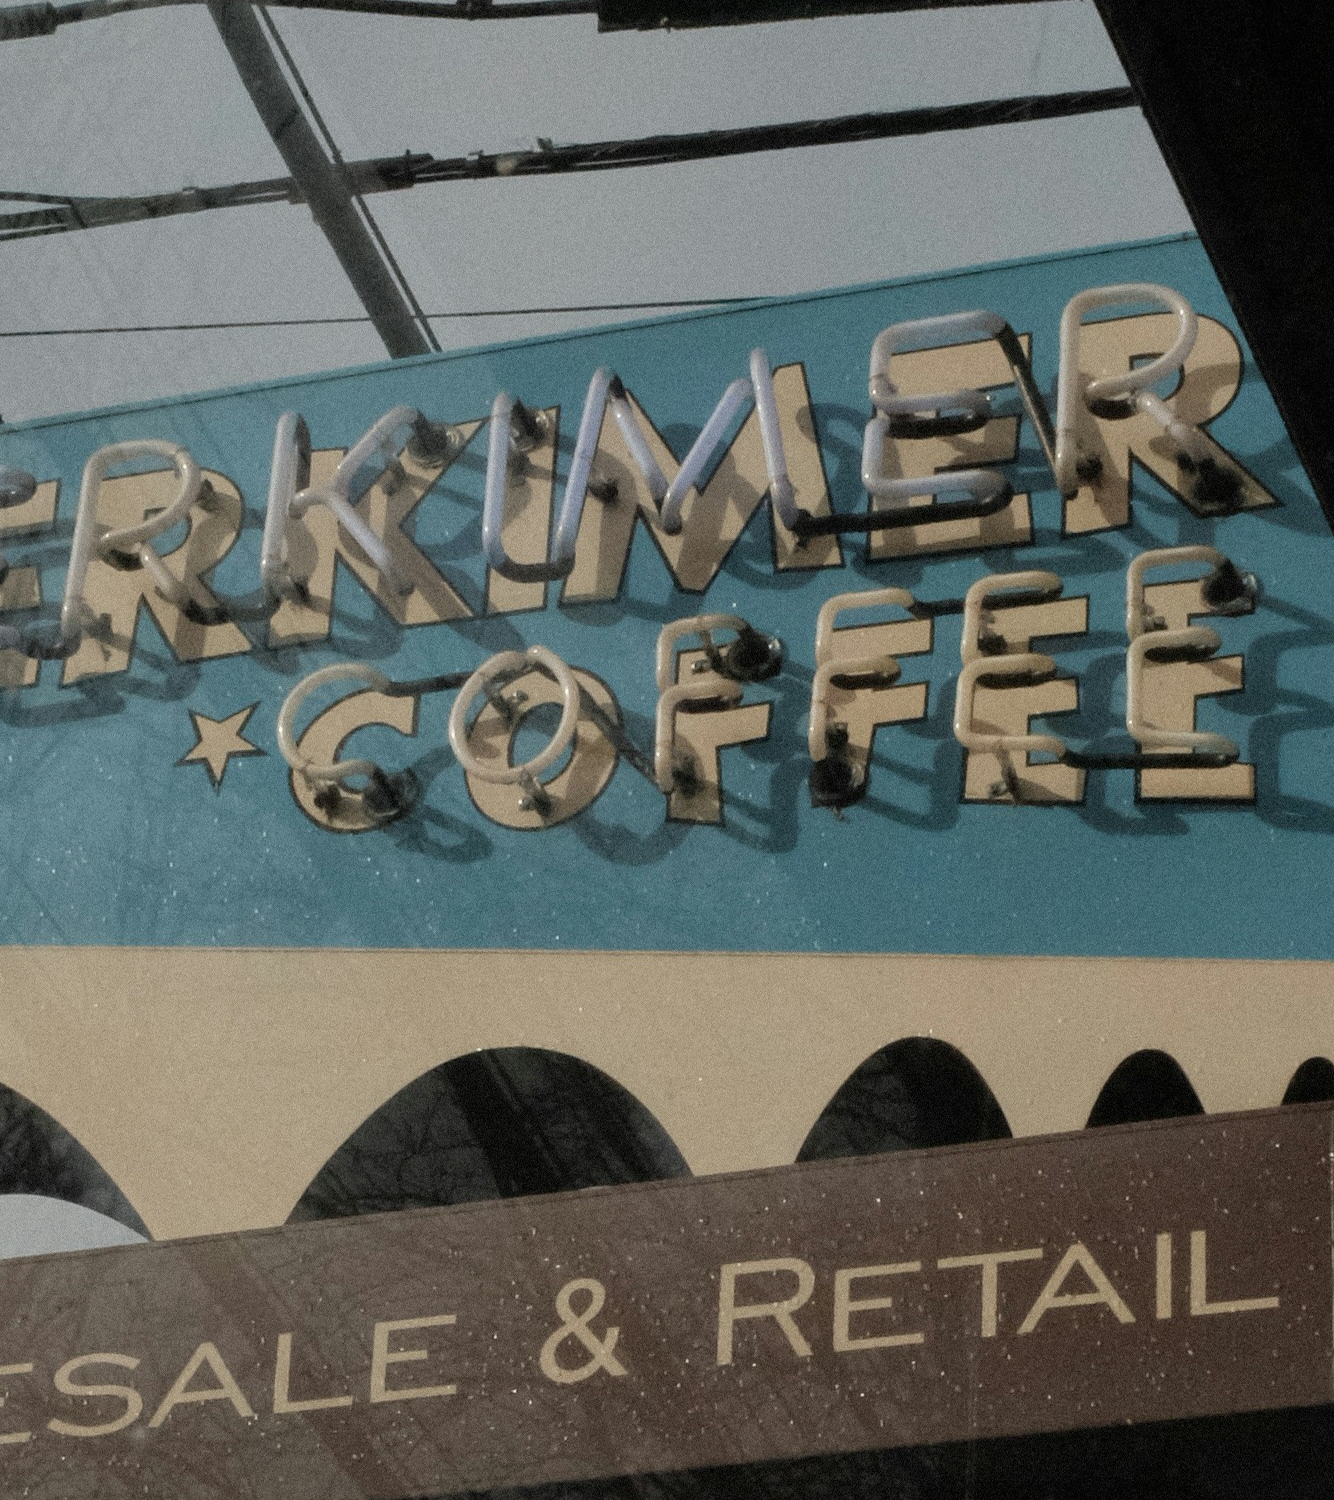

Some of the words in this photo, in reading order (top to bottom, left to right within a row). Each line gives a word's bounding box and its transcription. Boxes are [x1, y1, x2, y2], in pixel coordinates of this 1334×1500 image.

[277, 547, 1257, 831] COFFEE
[538, 1277, 625, 1387] &
[716, 1229, 1281, 1366] RETAIL
